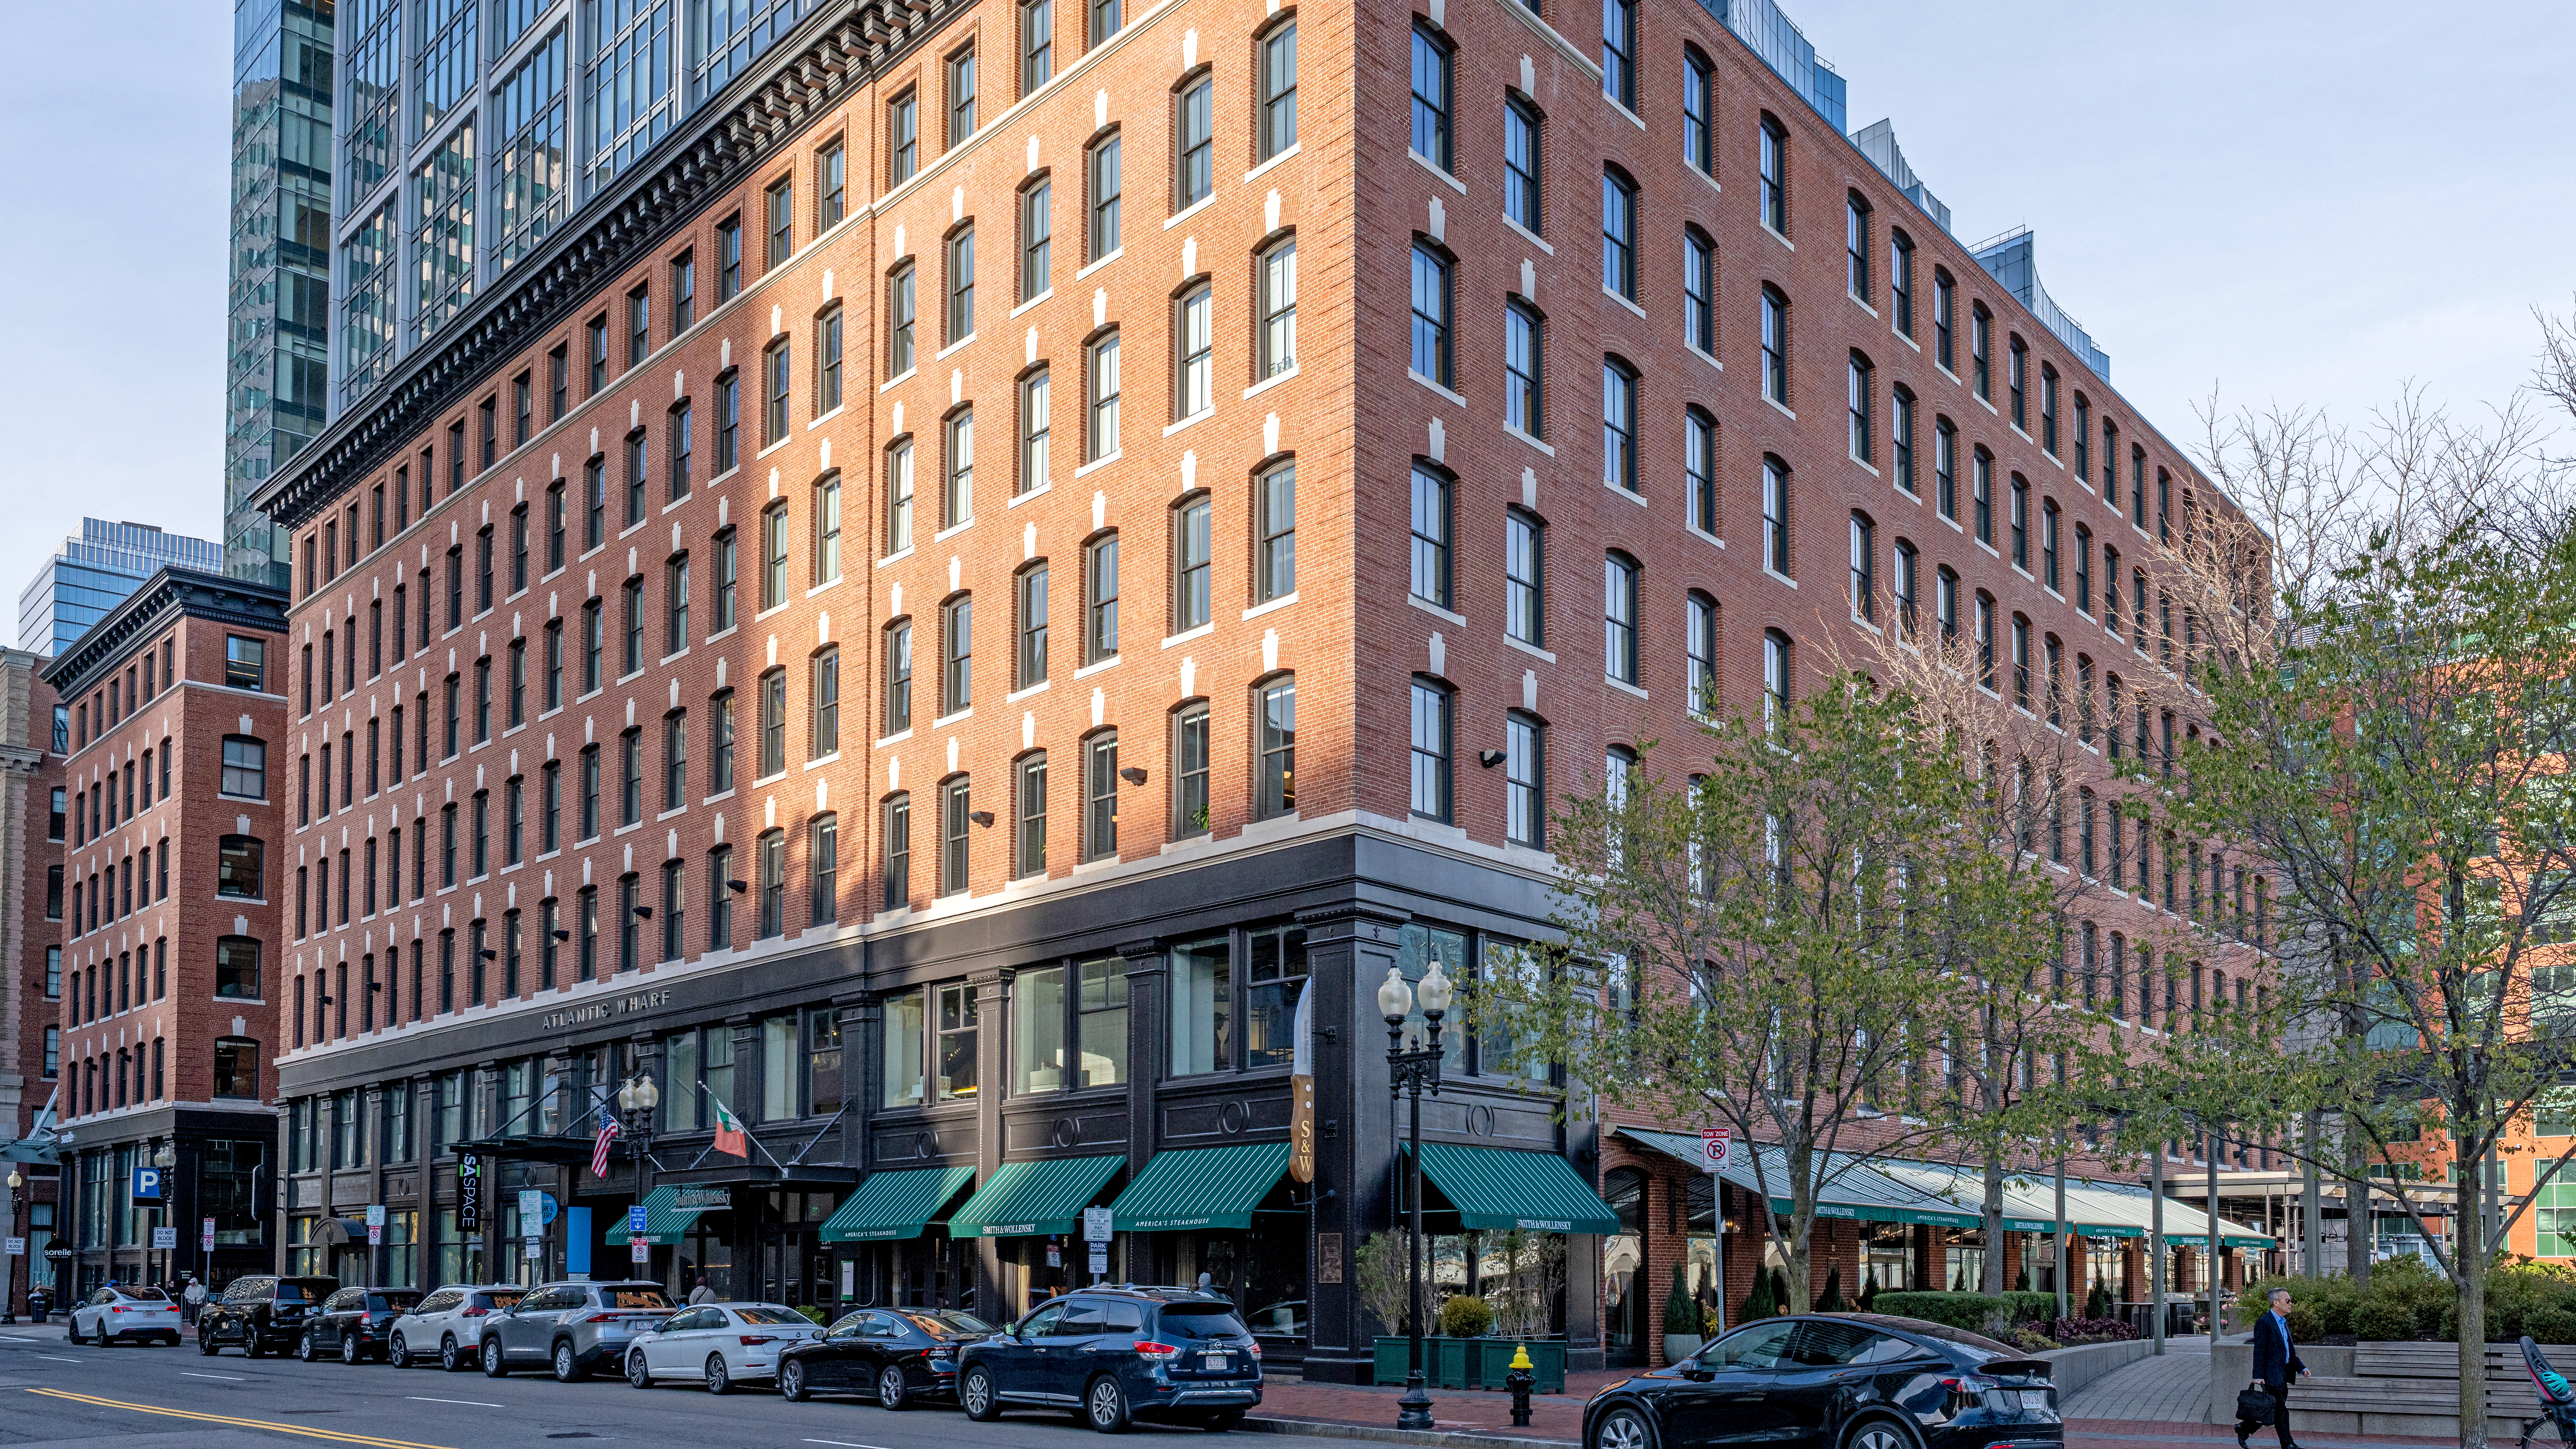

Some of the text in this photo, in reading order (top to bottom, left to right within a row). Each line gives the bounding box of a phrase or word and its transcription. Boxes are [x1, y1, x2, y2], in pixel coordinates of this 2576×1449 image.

[543, 990, 670, 1029] ATLANTIC WHARF
[140, 1171, 158, 1193] P
